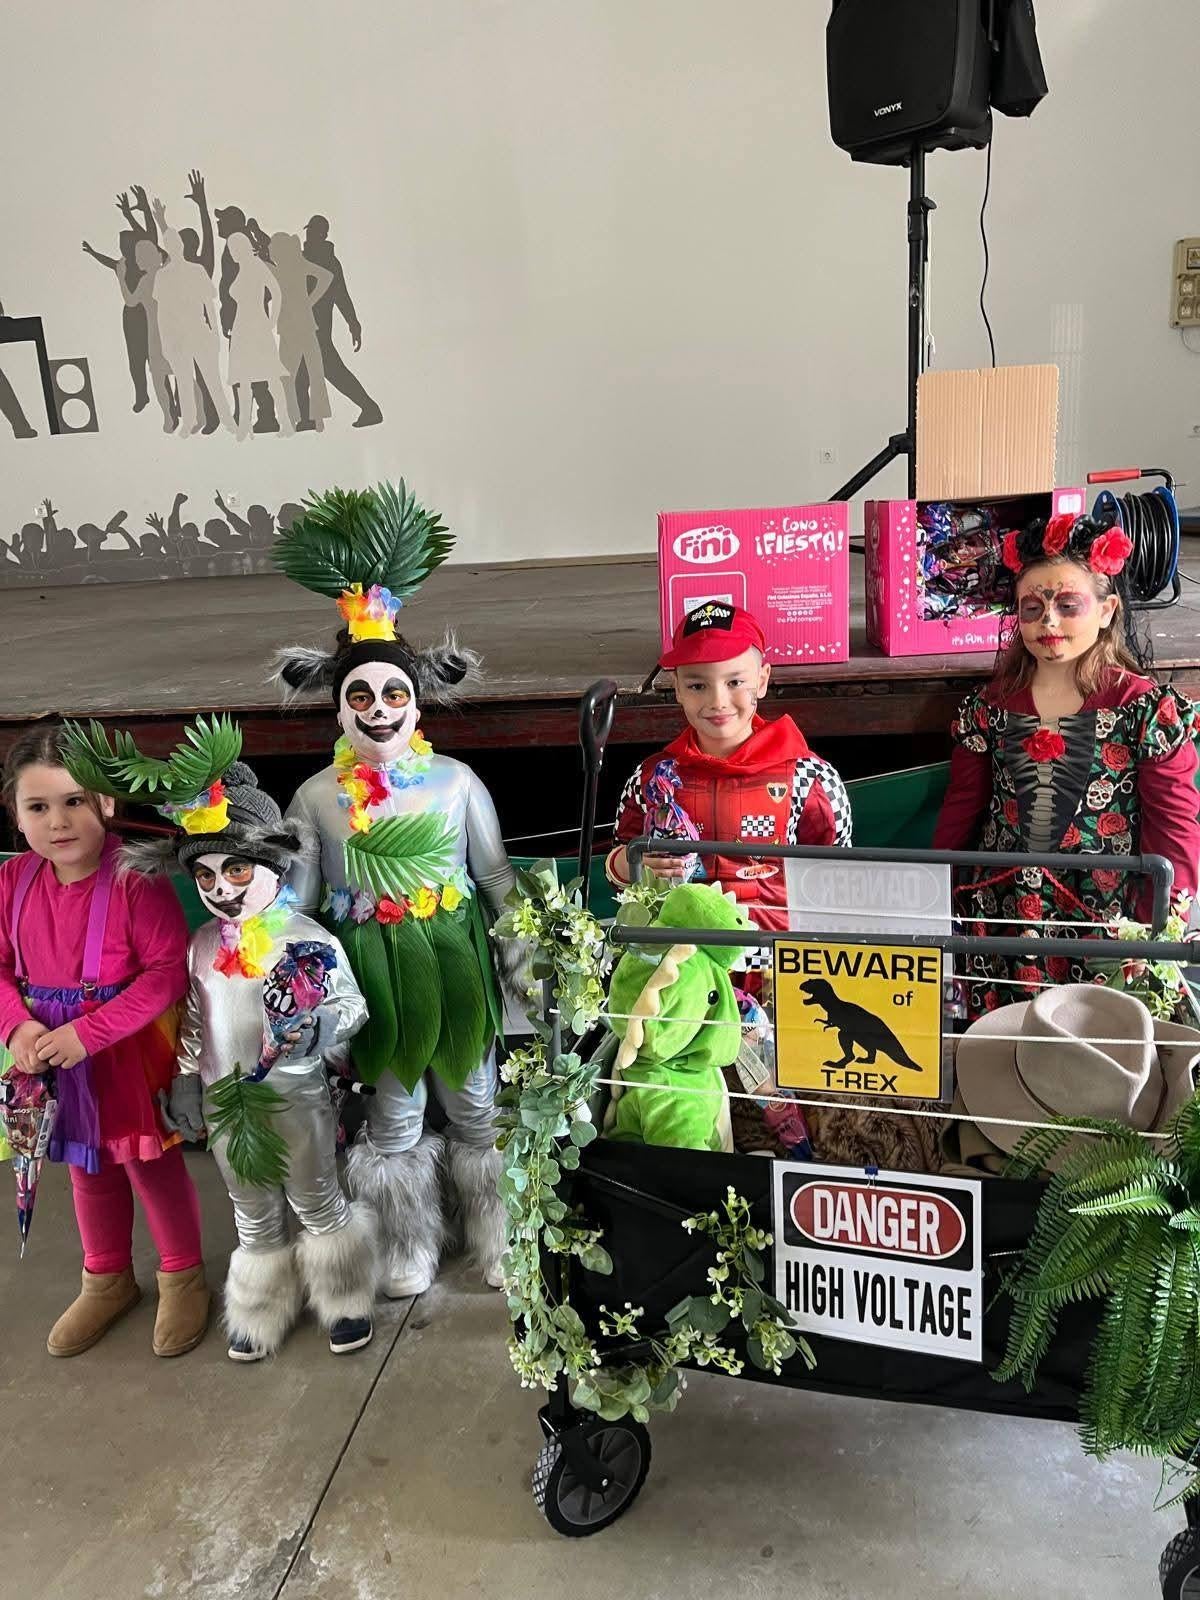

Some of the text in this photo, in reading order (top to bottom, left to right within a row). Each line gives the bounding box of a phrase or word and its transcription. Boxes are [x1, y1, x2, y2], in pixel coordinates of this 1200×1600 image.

[874, 101, 902, 116] VONYX
[680, 525, 732, 560] Fini
[754, 530, 844, 557] ¡FIESTA!
[778, 947, 938, 984] BEWARE
[892, 990, 914, 1007] of
[821, 1069, 898, 1093] T-REX
[813, 1188, 941, 1255] DANGER
[785, 1260, 972, 1341] HIGH VOLTAGE
